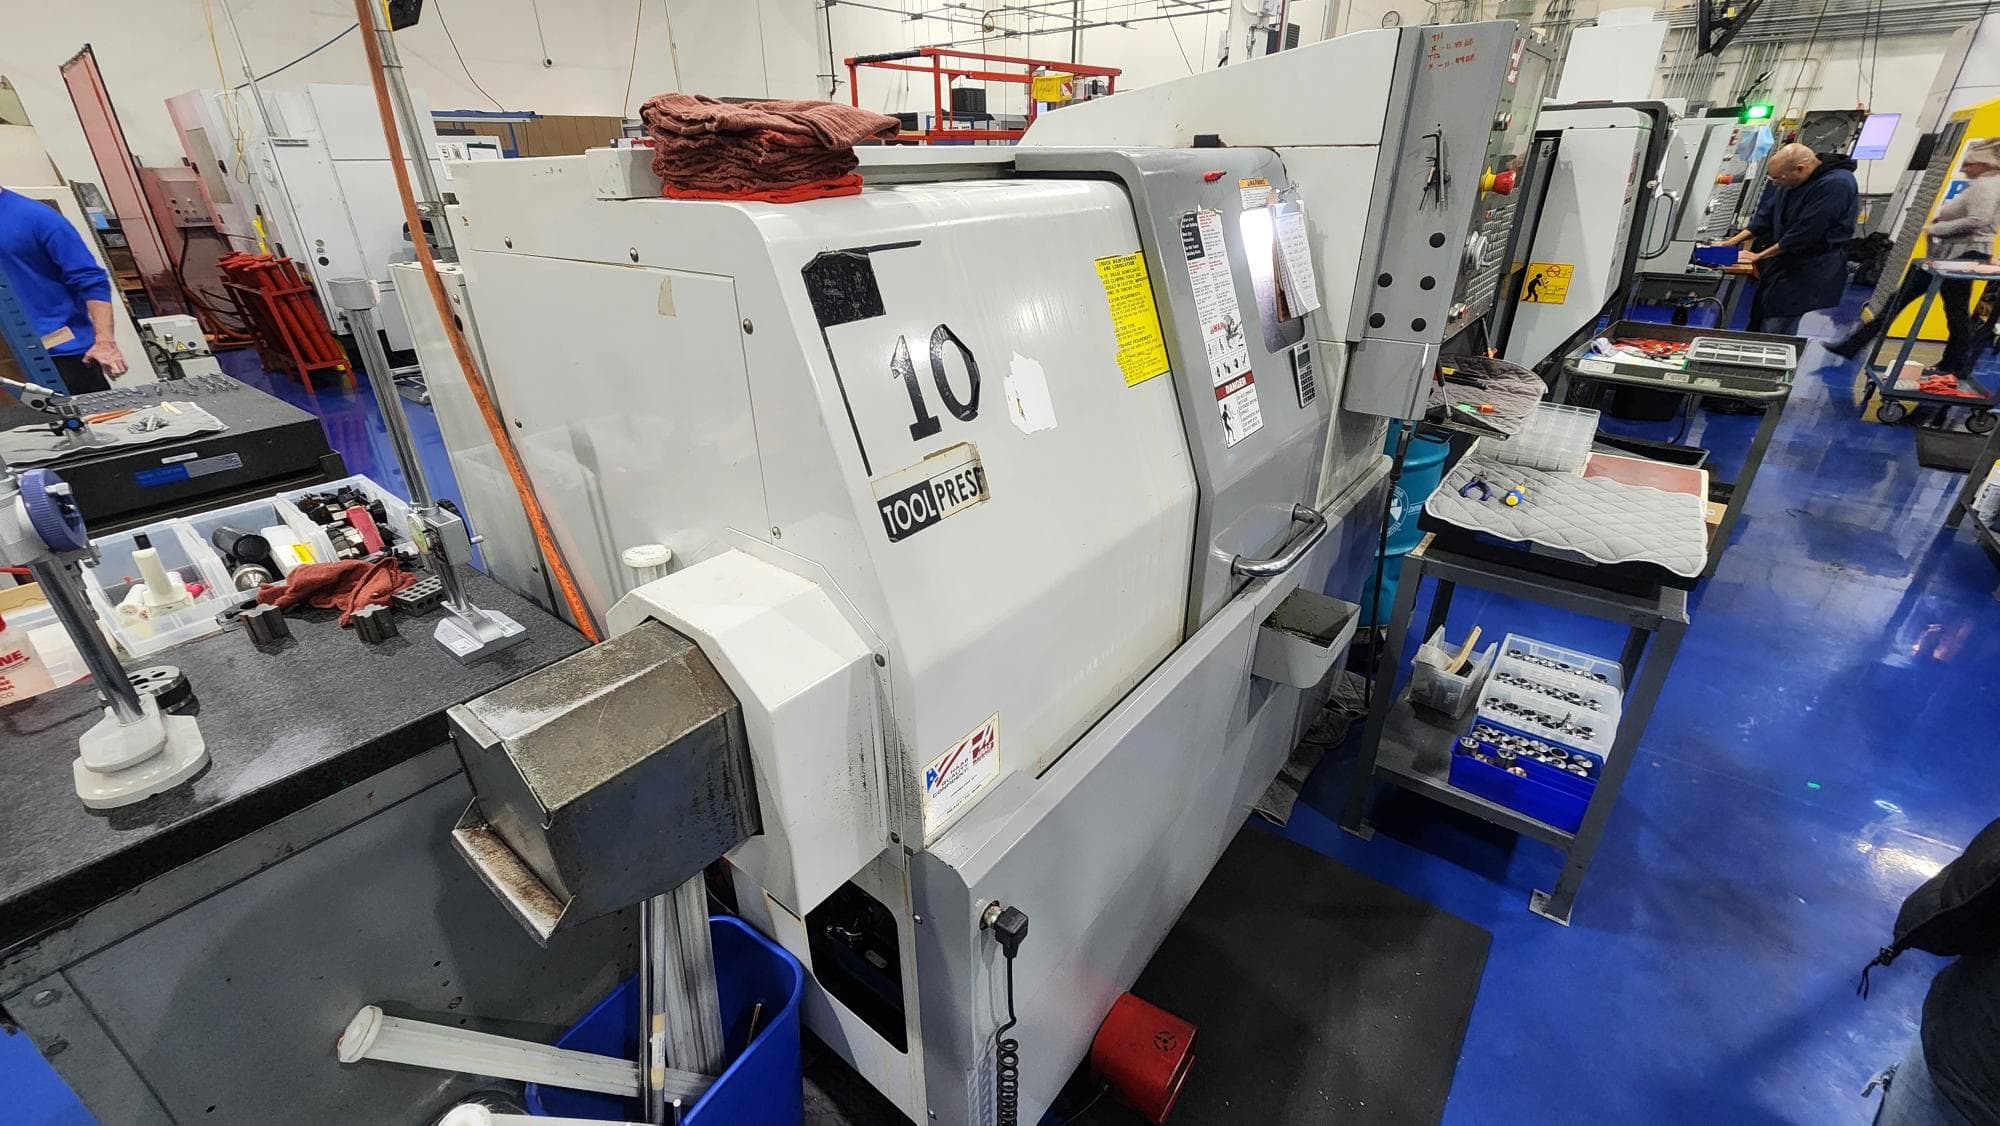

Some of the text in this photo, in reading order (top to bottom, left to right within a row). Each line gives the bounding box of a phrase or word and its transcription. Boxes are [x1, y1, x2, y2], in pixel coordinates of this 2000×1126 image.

[1112, 255, 1137, 264] MAINTENANCE
[1112, 261, 1136, 269] LUBRICATION
[890, 323, 981, 441] 10
[1224, 376, 1247, 395] DANGER
[883, 489, 937, 535] TOOL
